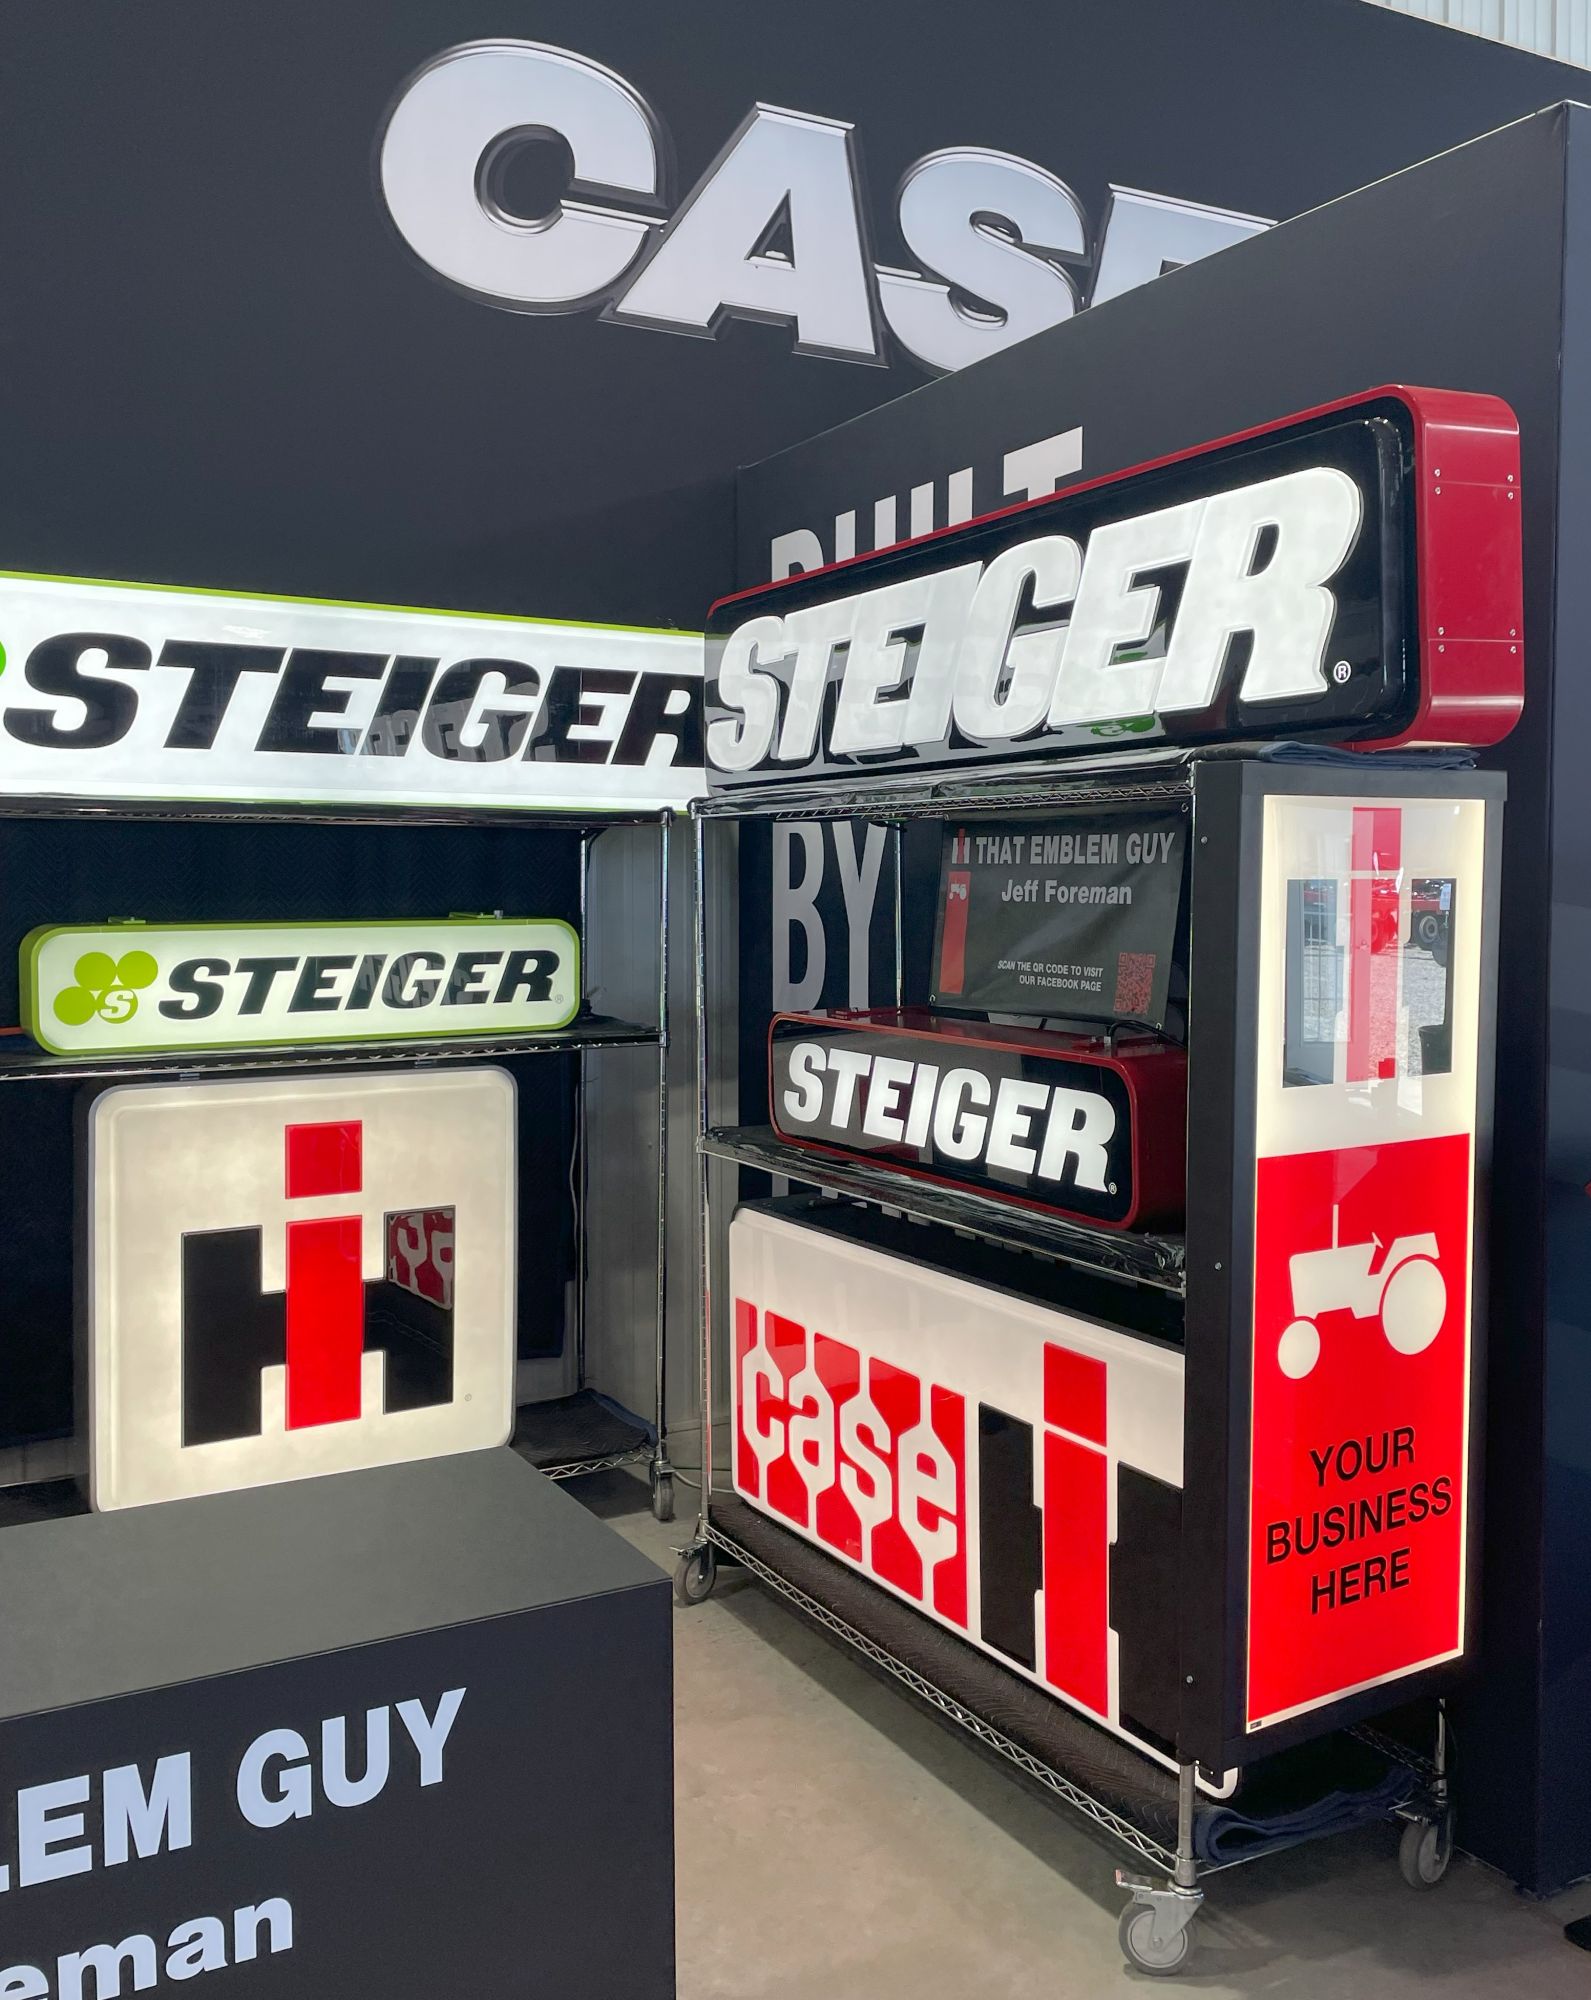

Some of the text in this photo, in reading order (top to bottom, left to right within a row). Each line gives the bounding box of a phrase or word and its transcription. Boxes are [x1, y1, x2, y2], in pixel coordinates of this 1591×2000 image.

[705, 466, 1363, 772] STEIGER
[3, 631, 704, 768] STEIGER
[976, 836, 1025, 864] THAT
[1030, 833, 1118, 864] EMBLEM
[1126, 832, 1175, 864] GUY
[772, 820, 888, 1012] BY
[1002, 879, 1132, 904] Jeff Foreman
[158, 950, 559, 1019] STEIGER
[997, 960, 1104, 978] SCAN THE QR CODE TO VISIT
[1019, 974, 1102, 992] OUR FACEBOOK PAGE
[783, 1043, 1116, 1193] STEIGER
[1310, 1426, 1416, 1487] YOUR
[1266, 1476, 1452, 1565] BUSINESS
[1311, 1548, 1412, 1615] HERE
[0, 1687, 467, 1892] EM GUY
